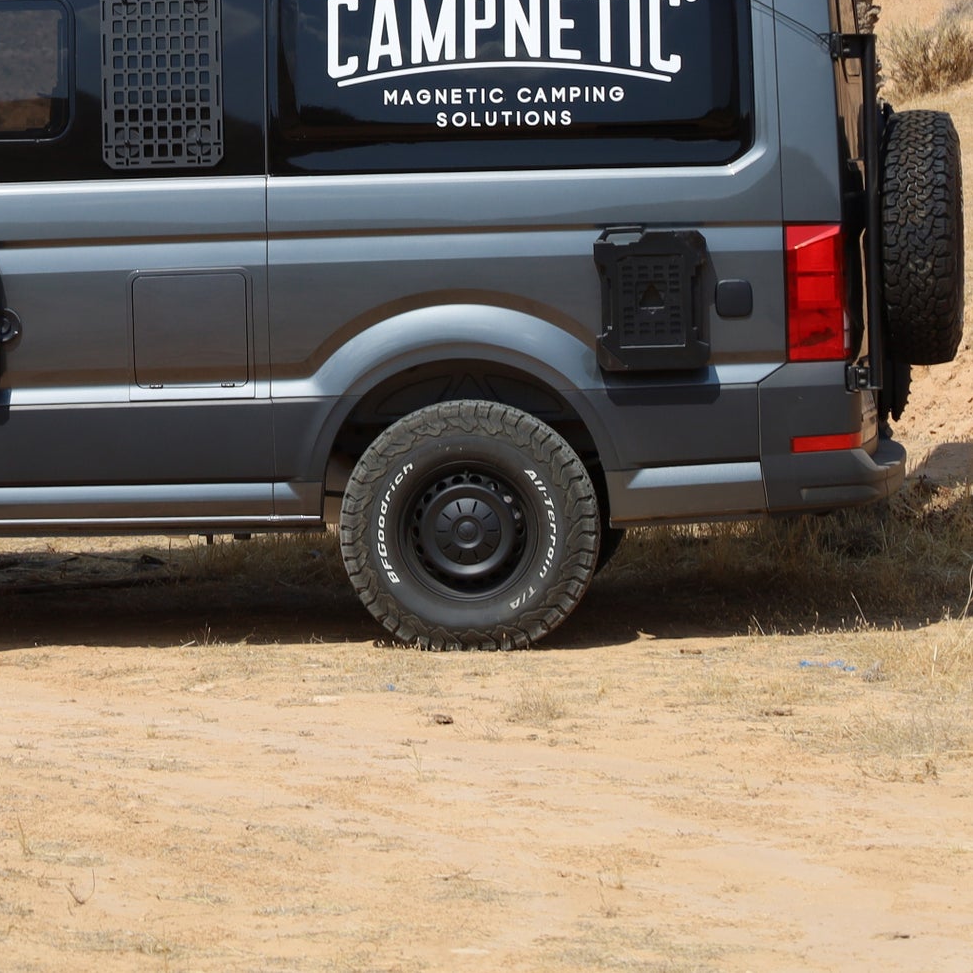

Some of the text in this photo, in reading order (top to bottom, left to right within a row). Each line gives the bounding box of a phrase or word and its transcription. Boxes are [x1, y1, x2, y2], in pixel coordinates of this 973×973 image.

[383, 85, 625, 106] MAGNETIC CAMPING
[436, 110, 572, 127] SOLUTIONS
[377, 462, 414, 585] BFGoodrich
